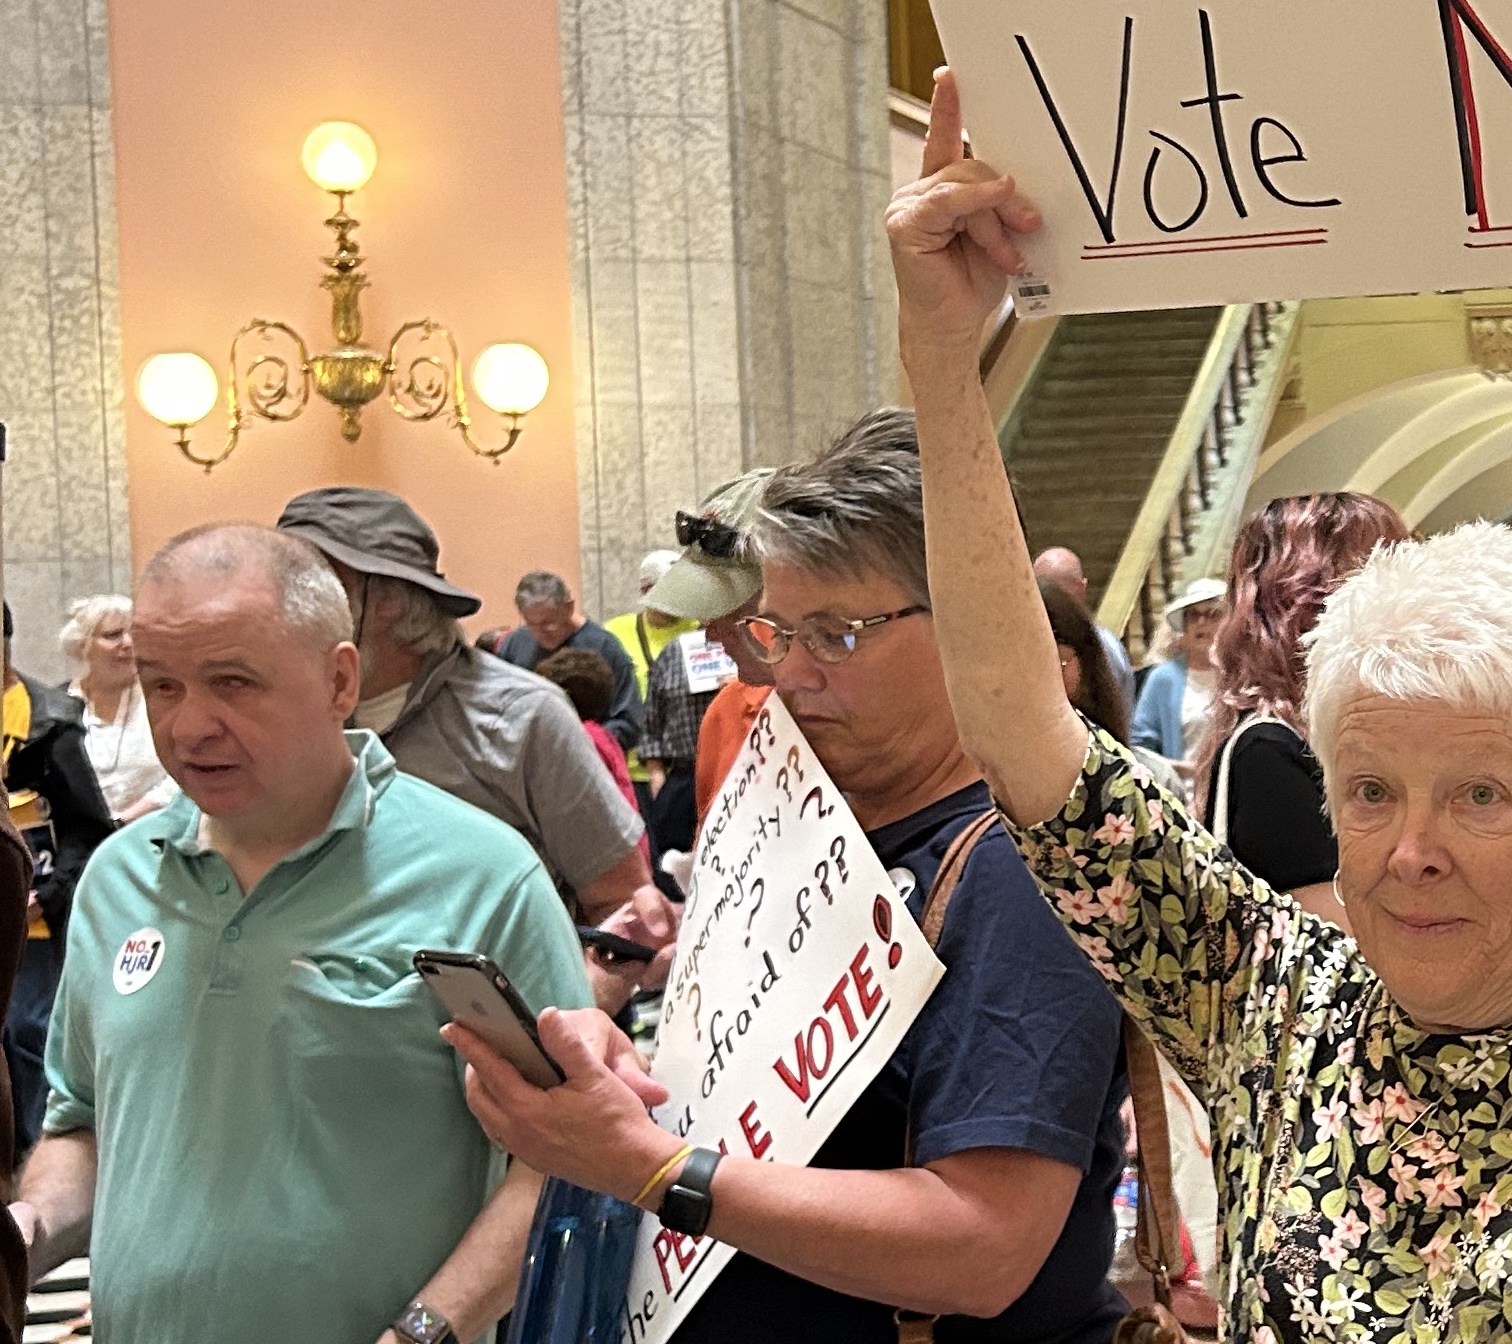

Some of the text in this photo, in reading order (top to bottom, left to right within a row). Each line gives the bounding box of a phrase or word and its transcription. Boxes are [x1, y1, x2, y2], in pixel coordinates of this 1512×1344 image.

[1015, 9, 1340, 242] Vote
[120, 941, 161, 974] HJR 1
[125, 940, 146, 954] NO
[701, 949, 782, 1099] afraid
